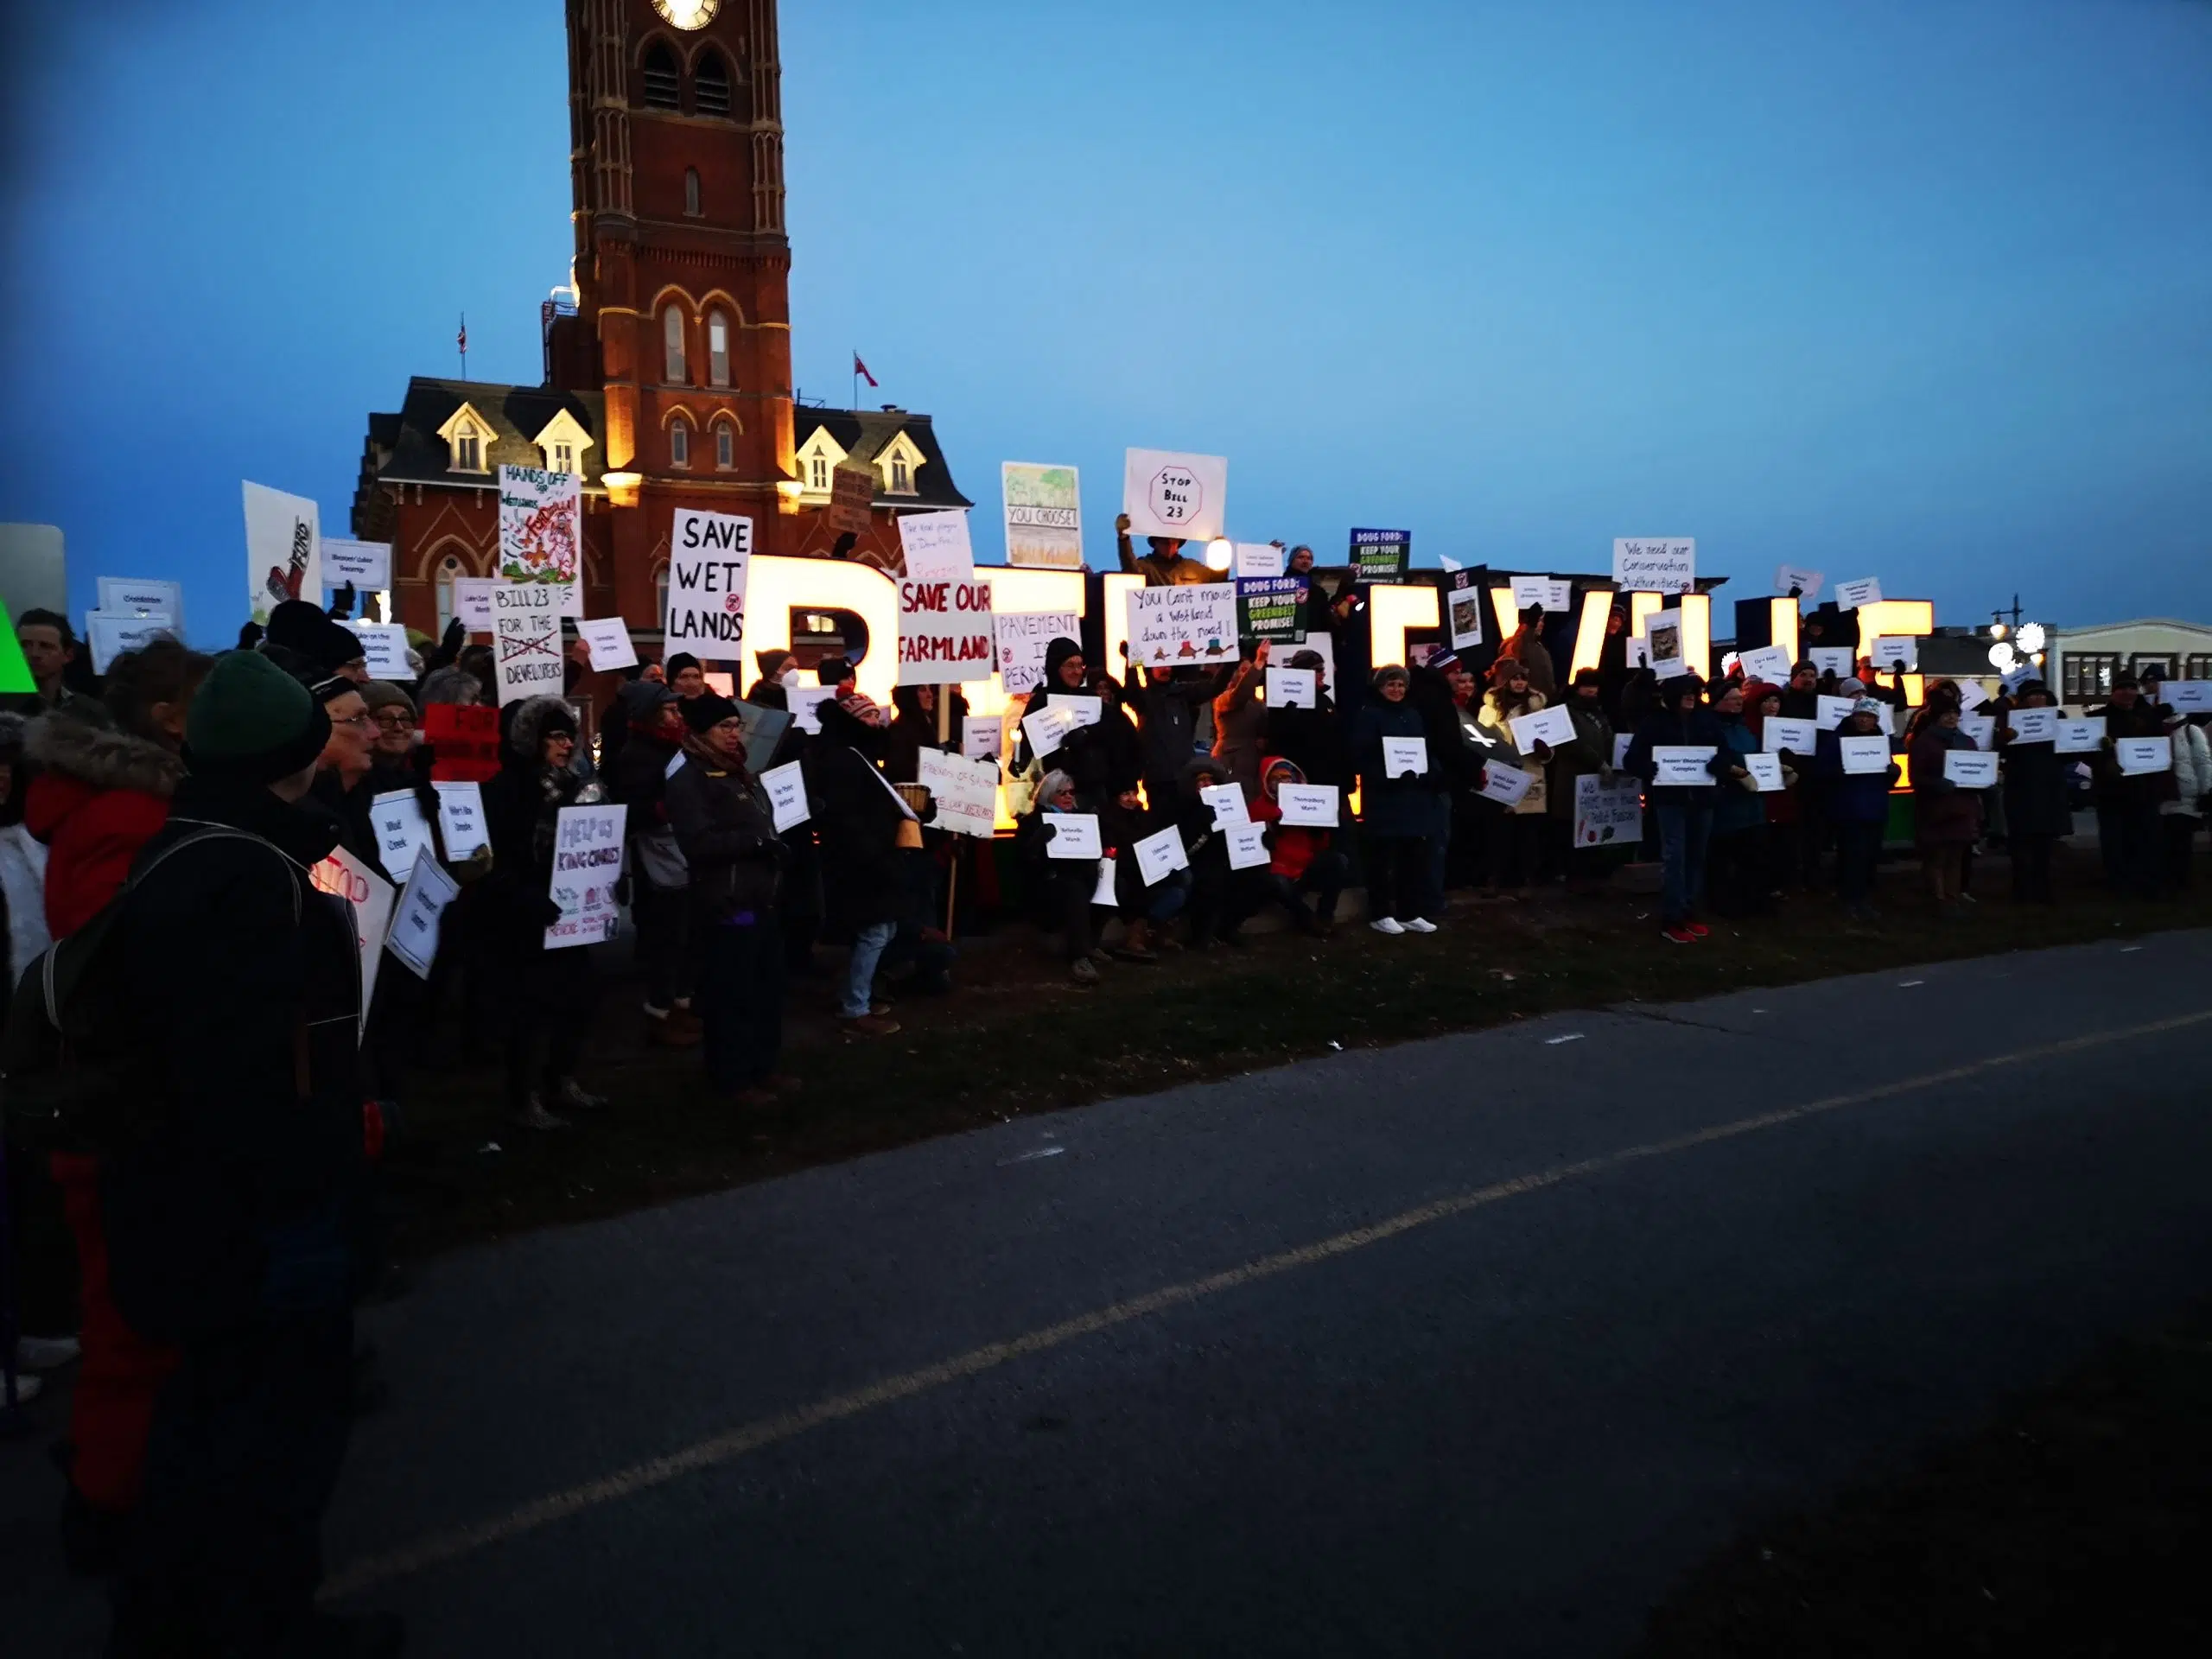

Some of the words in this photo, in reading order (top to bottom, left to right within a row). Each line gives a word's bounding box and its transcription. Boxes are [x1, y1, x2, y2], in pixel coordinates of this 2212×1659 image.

[505, 467, 545, 485] HANDS
[547, 472, 569, 486] OFF
[1008, 507, 1032, 524] YOU
[1166, 505, 1183, 518] 23
[683, 518, 748, 553] SAVE
[1357, 532, 1379, 543] DOUG
[1380, 531, 1403, 542] FORD:
[293, 522, 311, 569] FORD
[1360, 545, 1378, 556] KEEP
[1380, 544, 1400, 555] YOUR
[1624, 543, 1643, 556] We
[1623, 557, 1688, 571] Conservation
[677, 563, 741, 593] WET
[1243, 580, 1269, 594] DOUG
[1272, 577, 1300, 591] FORD:
[535, 588, 550, 607] 23
[901, 582, 950, 613] SAVE
[956, 583, 991, 613] OUR
[1248, 596, 1271, 609] KEEP
[1272, 594, 1296, 607] YOUR
[1156, 613, 1163, 623] a
[1249, 605, 1296, 620] GREENBELT
[499, 618, 524, 634] FOR
[530, 615, 552, 631] THE
[671, 607, 744, 642] LANDS
[1000, 614, 1076, 639] PAVEMENT
[1251, 617, 1294, 632] PROMISE!
[1141, 626, 1167, 642] down
[1171, 626, 1190, 640] the
[899, 634, 989, 664] FARMLAND
